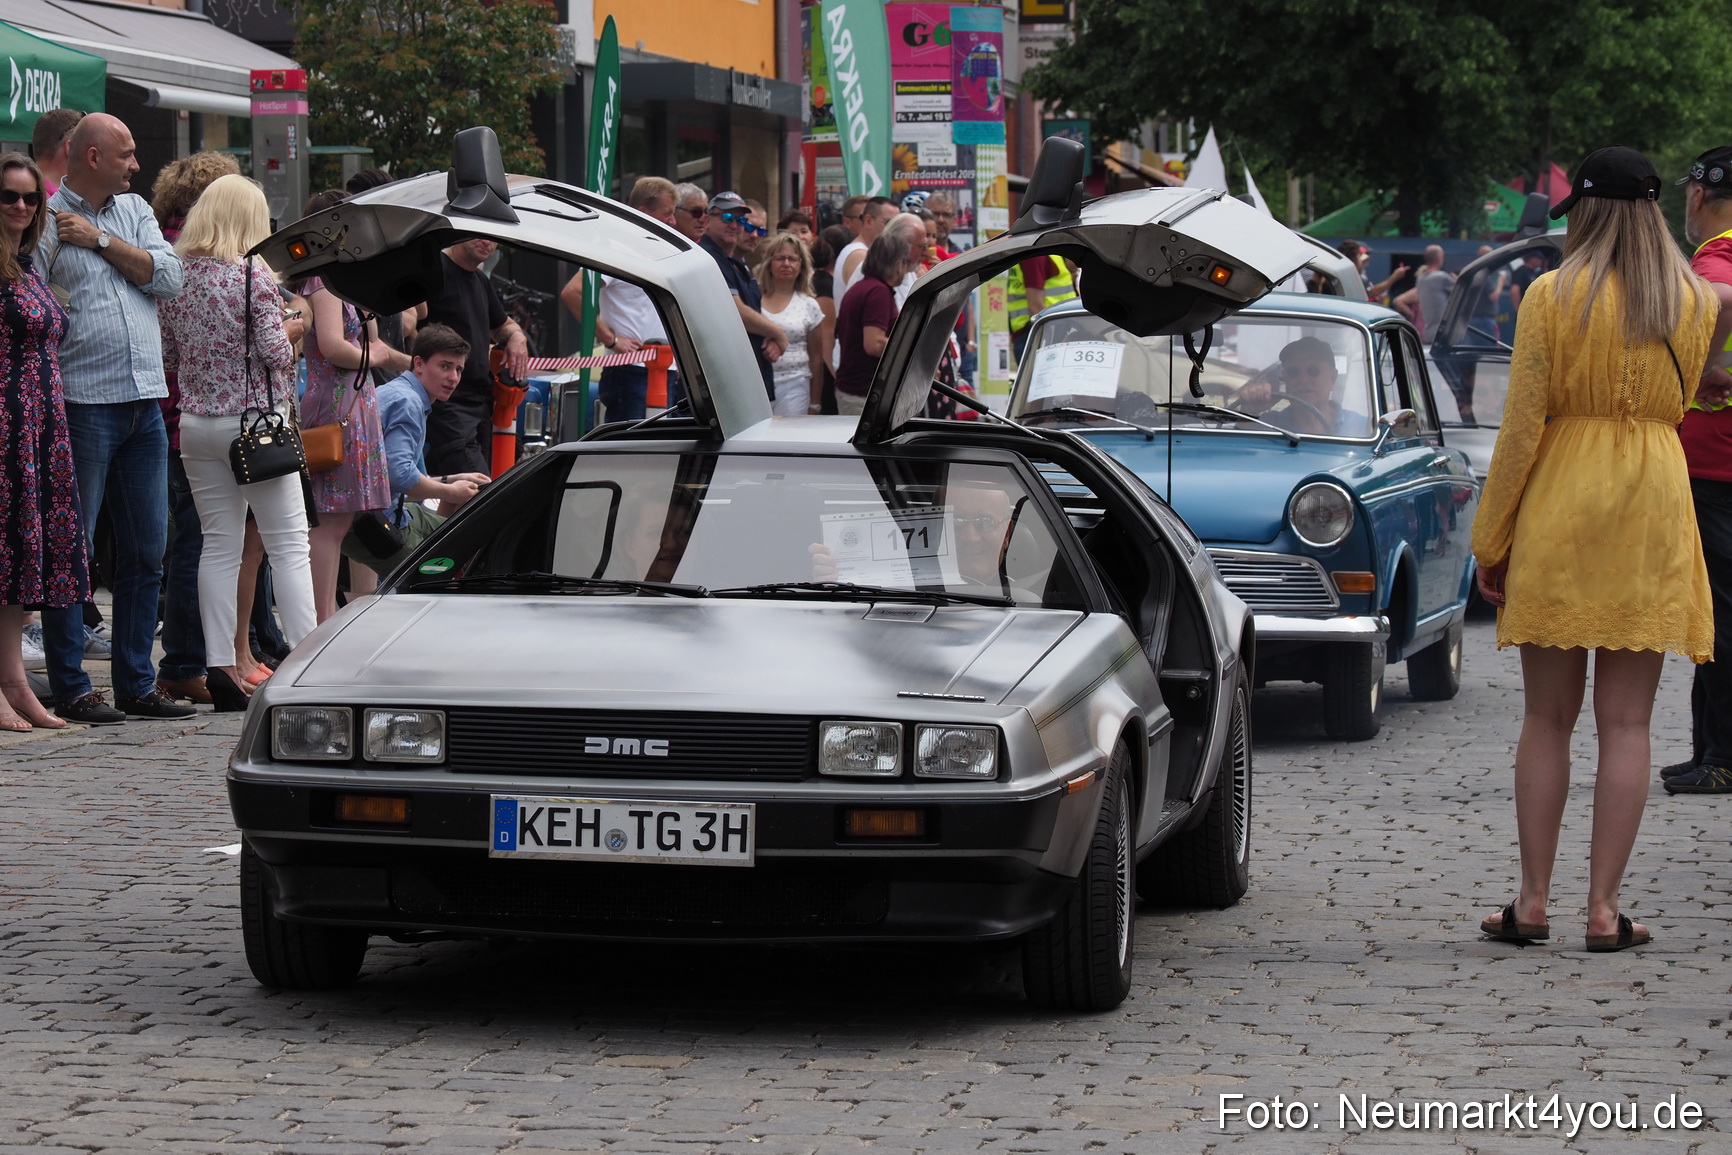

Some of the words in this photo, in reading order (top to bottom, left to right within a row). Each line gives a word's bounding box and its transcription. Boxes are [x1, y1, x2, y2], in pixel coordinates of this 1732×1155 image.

[25, 68, 61, 113] DEKRA
[259, 102, 287, 111] HotSpot
[897, 113, 907, 121] Fr.
[908, 113, 916, 121] 7.
[917, 113, 933, 121] Juni
[934, 113, 944, 121] 19
[894, 169, 957, 179] Erntedankfest
[958, 169, 976, 179] 2019
[1074, 351, 1105, 362] 363
[887, 526, 929, 551] 171
[500, 831, 509, 843] D
[519, 806, 601, 847] KEH
[629, 810, 682, 851] TG
[692, 812, 748, 853] 3H
